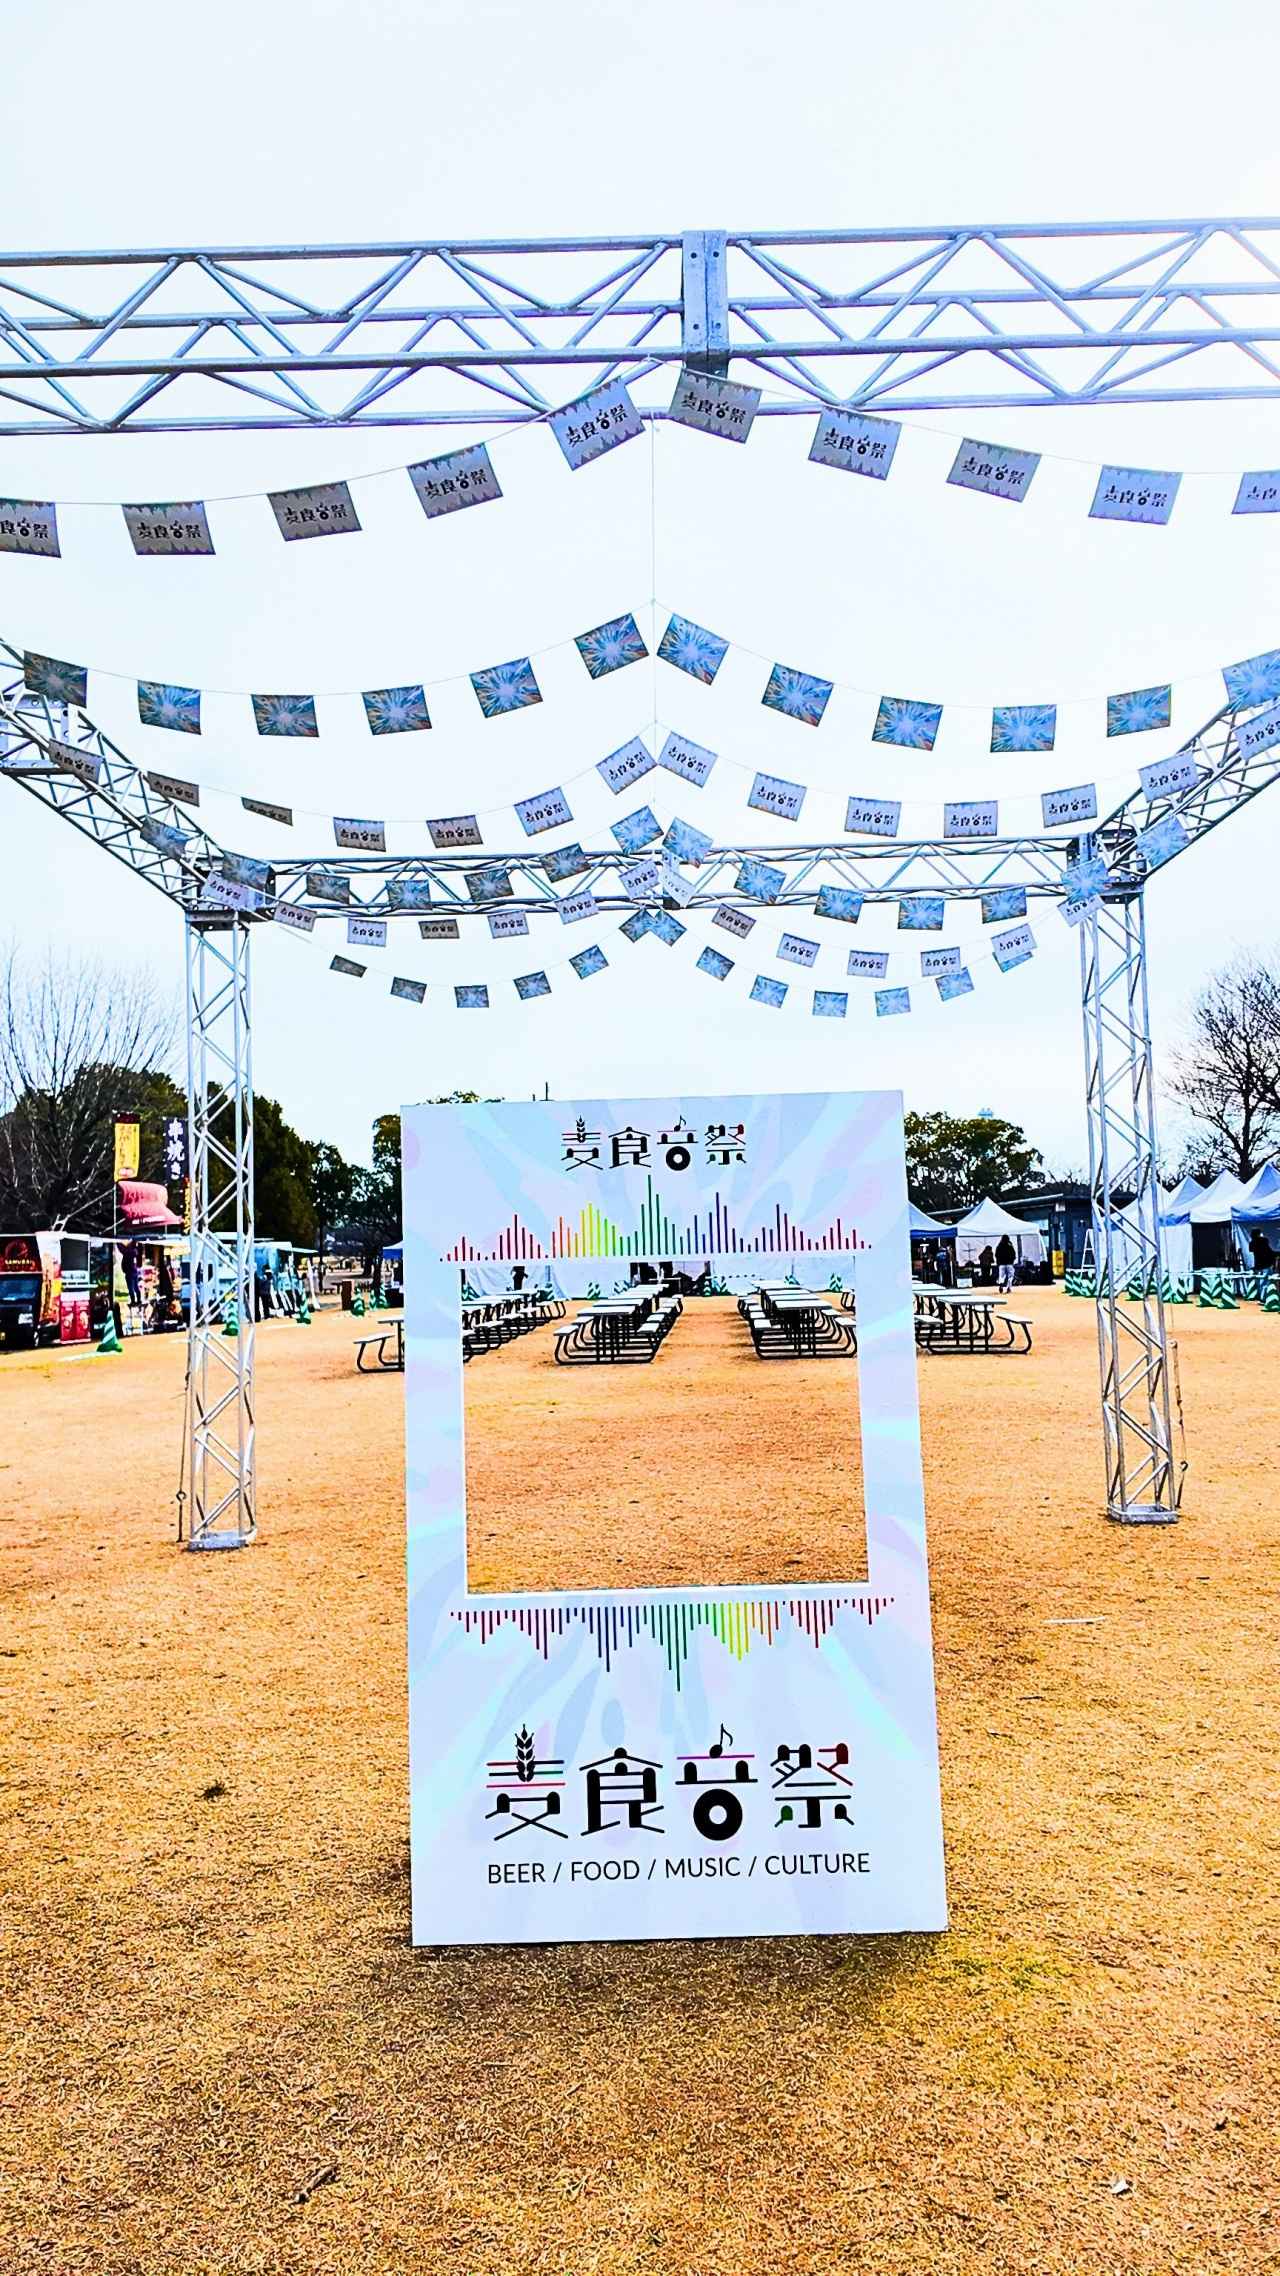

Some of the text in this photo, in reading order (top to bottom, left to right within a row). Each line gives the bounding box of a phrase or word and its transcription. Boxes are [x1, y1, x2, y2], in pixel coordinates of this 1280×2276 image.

[561, 1115, 746, 1171] 麦食音祭
[485, 1723, 854, 1841] 麦食音祭
[488, 1862, 546, 1884] BEER
[571, 1860, 640, 1882] FOOD
[665, 1857, 741, 1879] MUSIC
[764, 1853, 871, 1876] CULTURE
